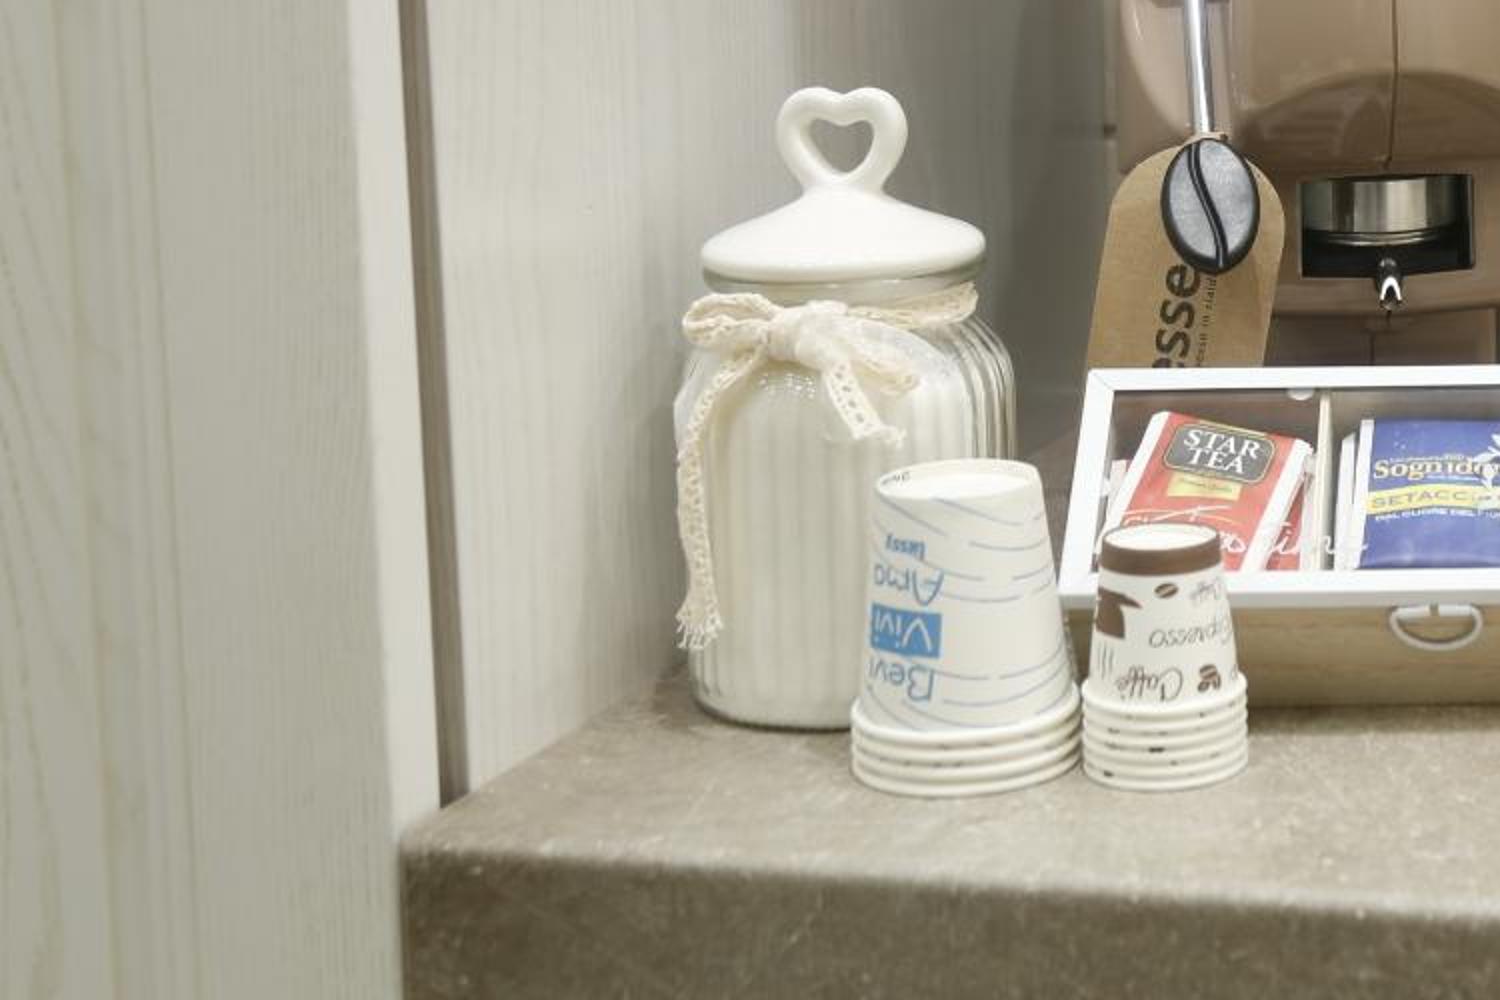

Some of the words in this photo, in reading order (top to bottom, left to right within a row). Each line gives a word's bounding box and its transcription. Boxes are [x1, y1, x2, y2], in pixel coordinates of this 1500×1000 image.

[1183, 429, 1262, 459] STAR
[1188, 448, 1245, 475] TEA
[873, 611, 933, 652] Vivi
[868, 661, 935, 702] Bevi
